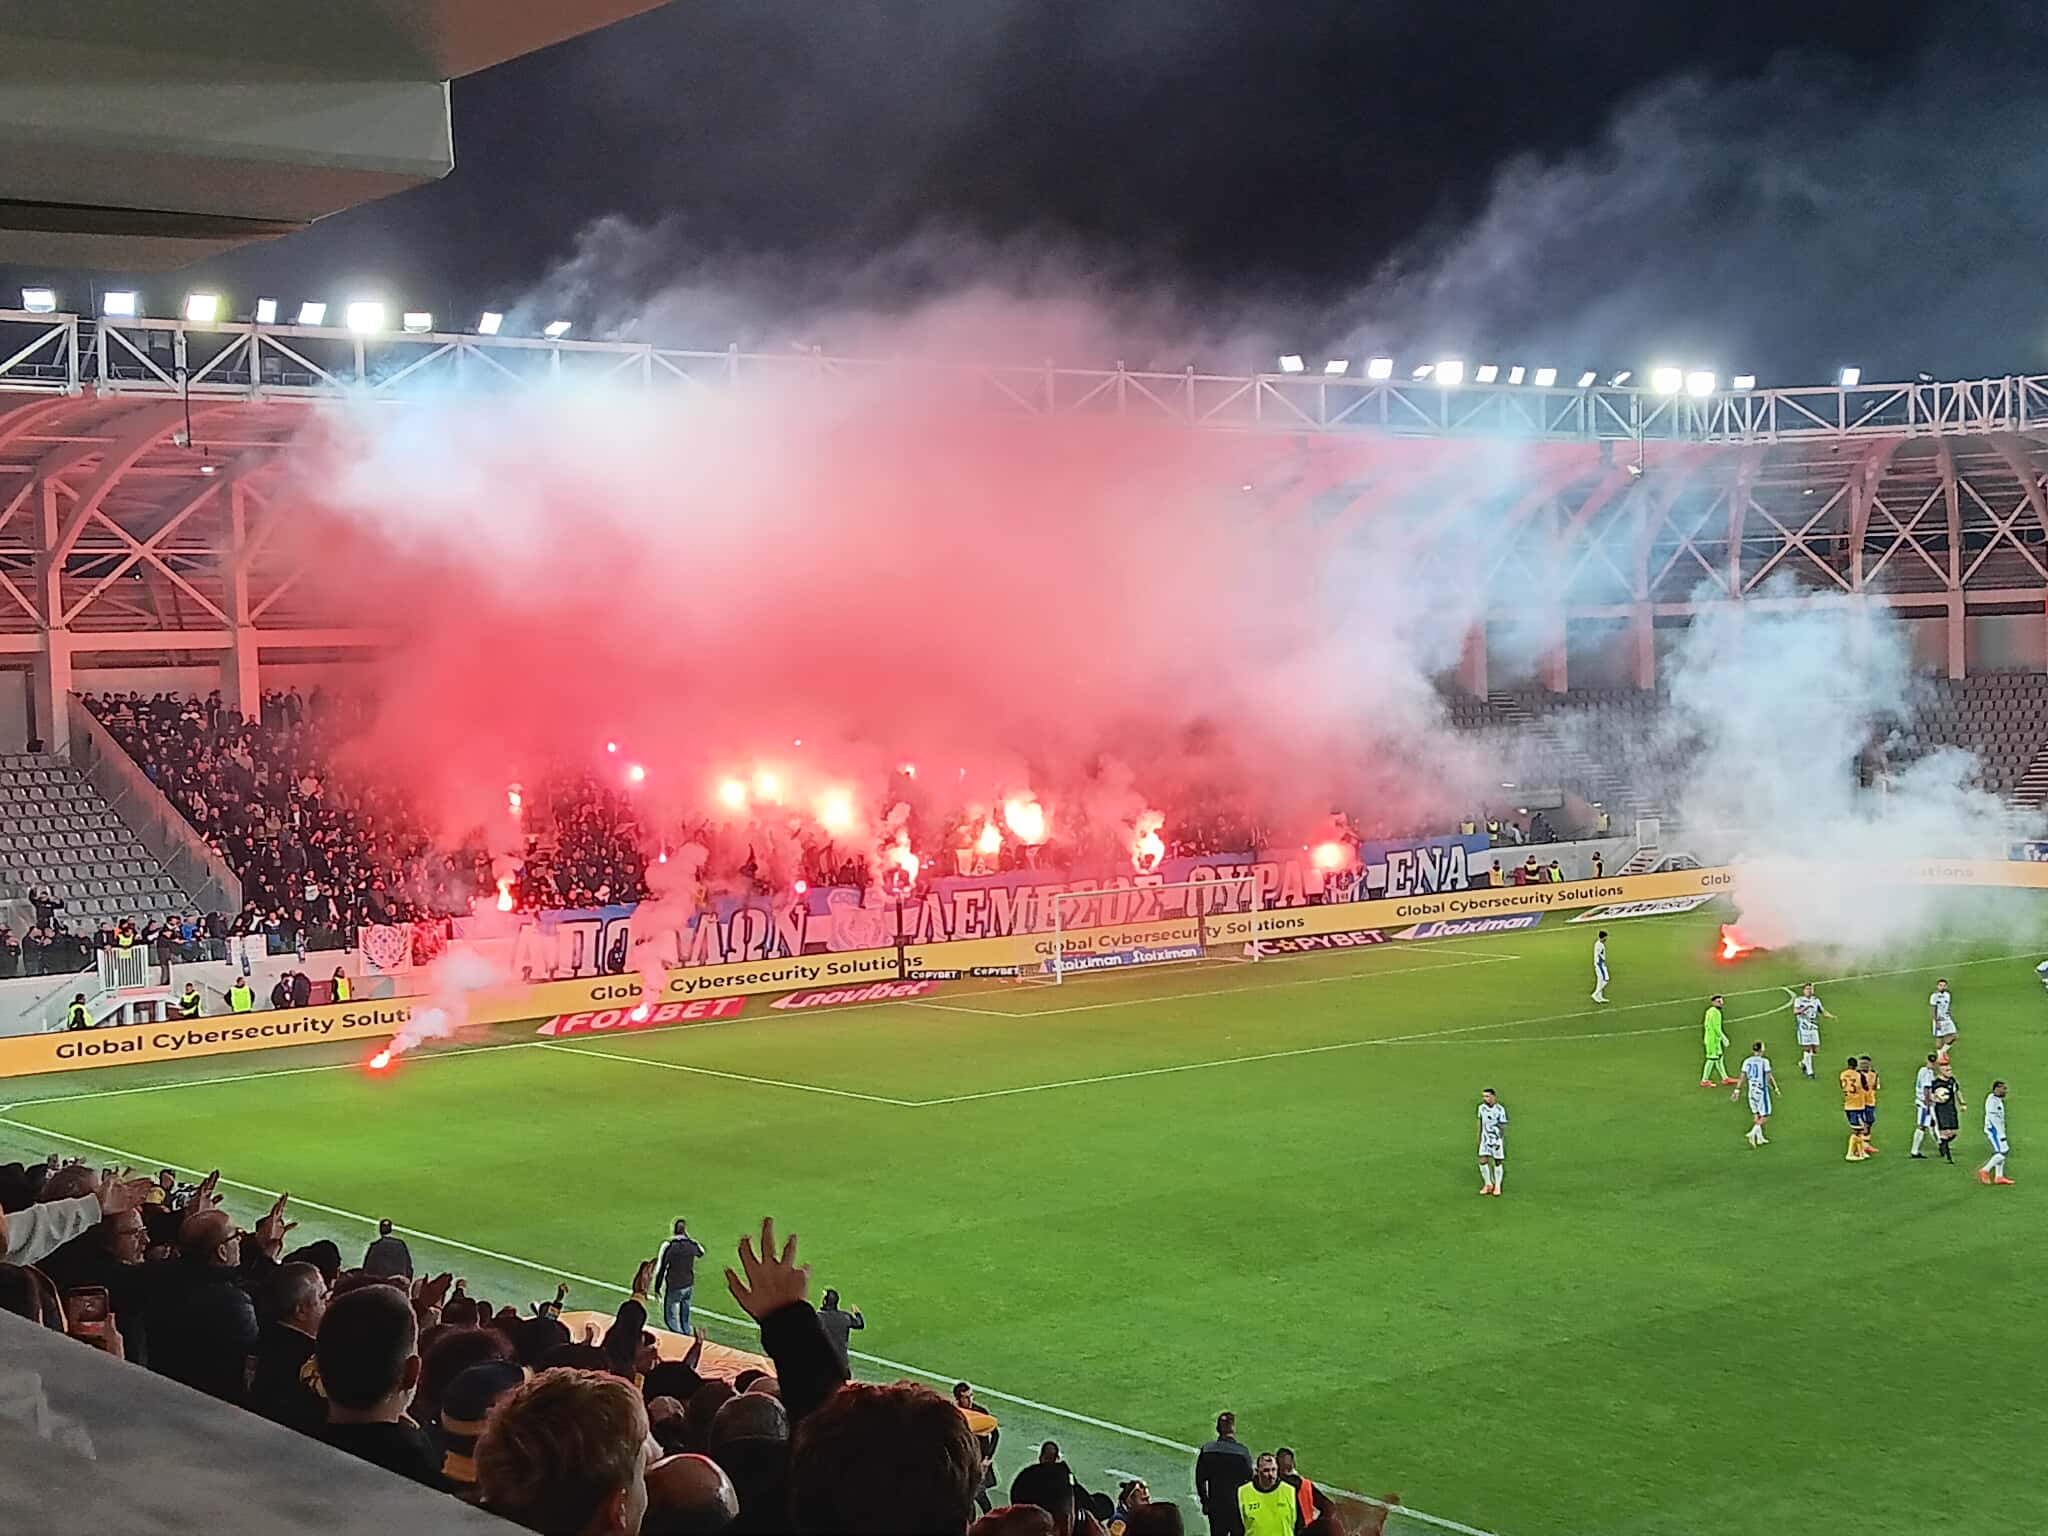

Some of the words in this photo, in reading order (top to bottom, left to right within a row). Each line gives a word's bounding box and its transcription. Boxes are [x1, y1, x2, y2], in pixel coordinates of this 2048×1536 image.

[1396, 901, 1445, 917] Global
[1450, 892, 1553, 912] Cybersecurity
[1558, 885, 1624, 900] Solutions
[1099, 926, 1221, 946] Cybersecurty
[1423, 916, 1534, 938] Stoiximan
[591, 983, 643, 1001] Glob
[670, 965, 820, 994] Cybersecurity
[827, 956, 923, 975] Solutions
[56, 1035, 142, 1059] Global
[153, 1016, 334, 1050] Cybersecurity
[343, 1006, 411, 1028] Soluti
